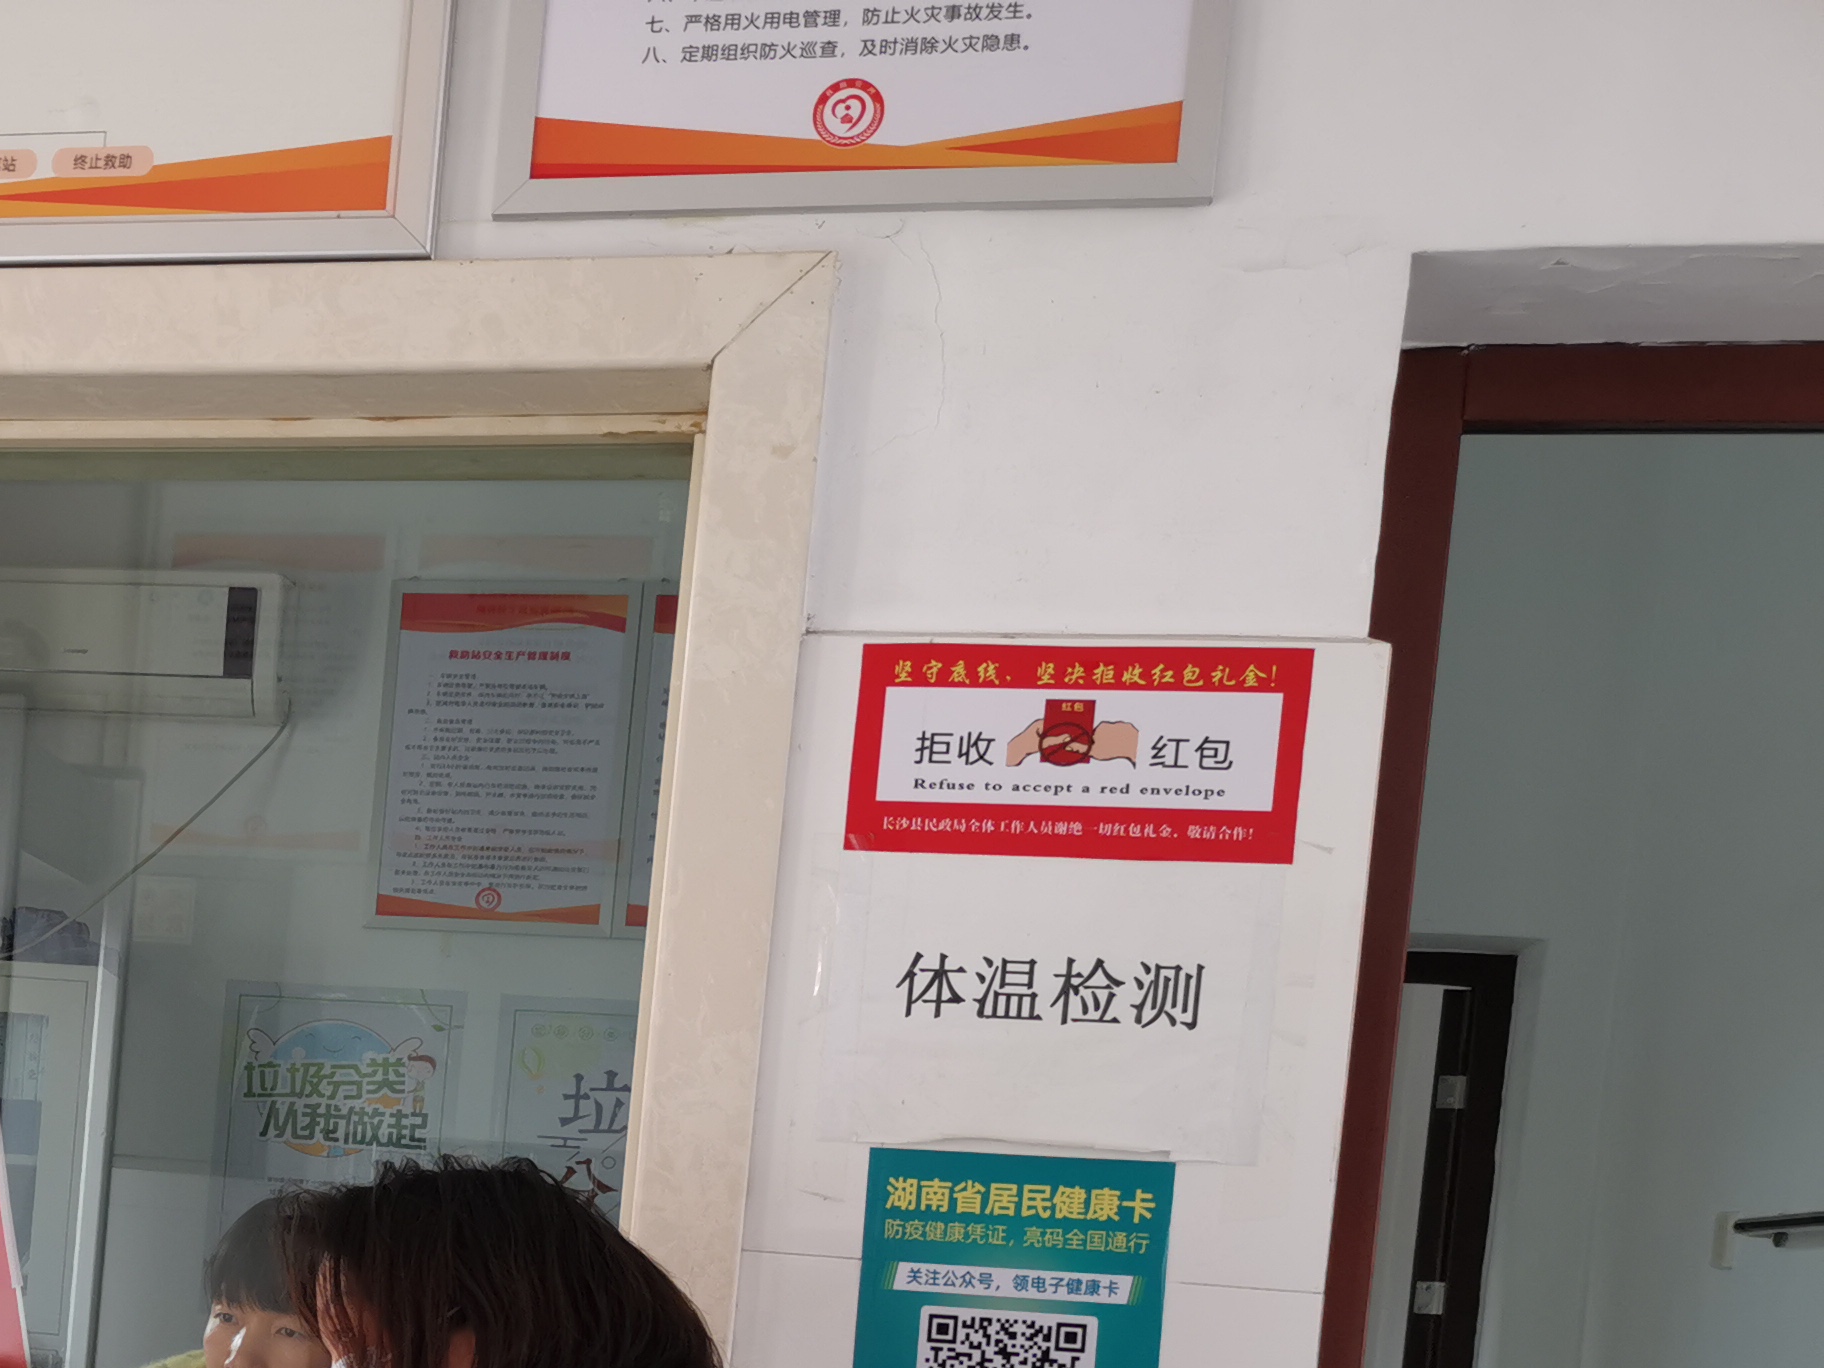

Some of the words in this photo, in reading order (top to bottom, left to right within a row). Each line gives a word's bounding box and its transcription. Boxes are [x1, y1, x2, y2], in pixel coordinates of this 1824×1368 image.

[645, 2, 1033, 33] 七、严格用火用电管理，防止火灾事故发生。
[641, 33, 1030, 64] 八、定期组织防火巡查，及时消除火灾隐患。
[72, 153, 133, 171] 终止救助
[1061, 701, 1085, 713] 红包
[914, 730, 996, 767] 拒收
[1149, 734, 1234, 771] 红包
[913, 777, 975, 792] Refuse
[984, 780, 1003, 792] to
[1012, 781, 1074, 797] accept
[1081, 785, 1091, 795] a
[1099, 782, 1131, 796] red
[1139, 783, 1226, 800] envelope
[895, 951, 1206, 1031] 体温检测
[242, 1057, 408, 1100] 垃圾分类
[259, 1100, 429, 1150] 从我做起
[885, 1176, 1156, 1224] 湖南省居民健康卡
[884, 1219, 1150, 1255] 防疫健康凭证，亮码全国通行
[906, 1268, 1120, 1297] 关注公众号，领电子健康卡
